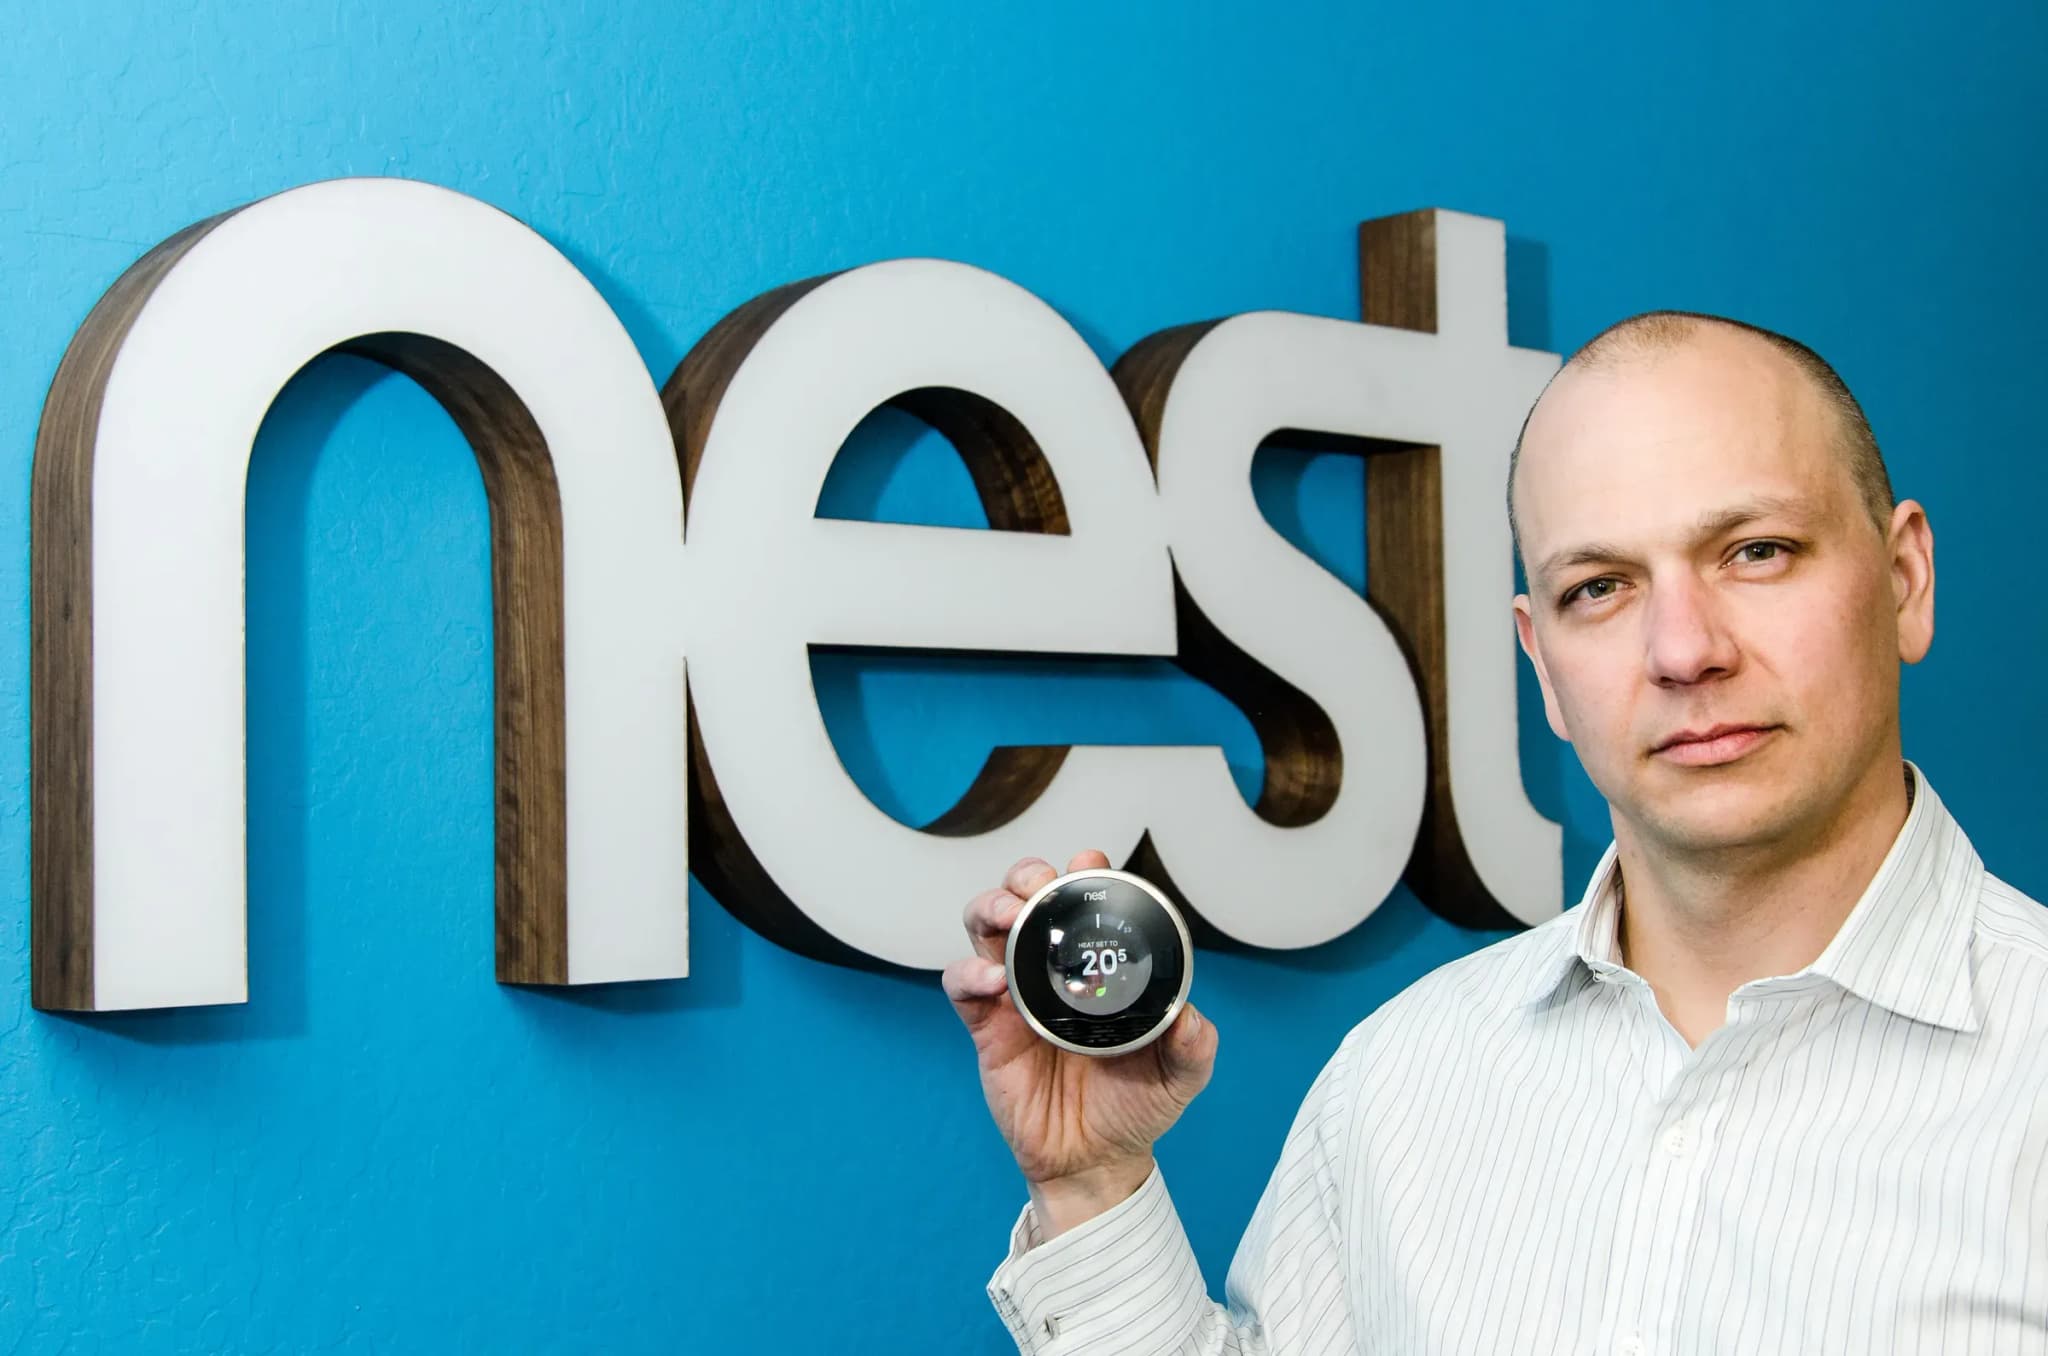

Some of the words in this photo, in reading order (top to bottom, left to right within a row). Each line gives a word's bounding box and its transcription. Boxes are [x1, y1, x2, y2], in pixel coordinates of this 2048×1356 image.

[31, 177, 1563, 1011] nest
[1084, 890, 1106, 901] nest
[1096, 940, 1107, 948] SET
